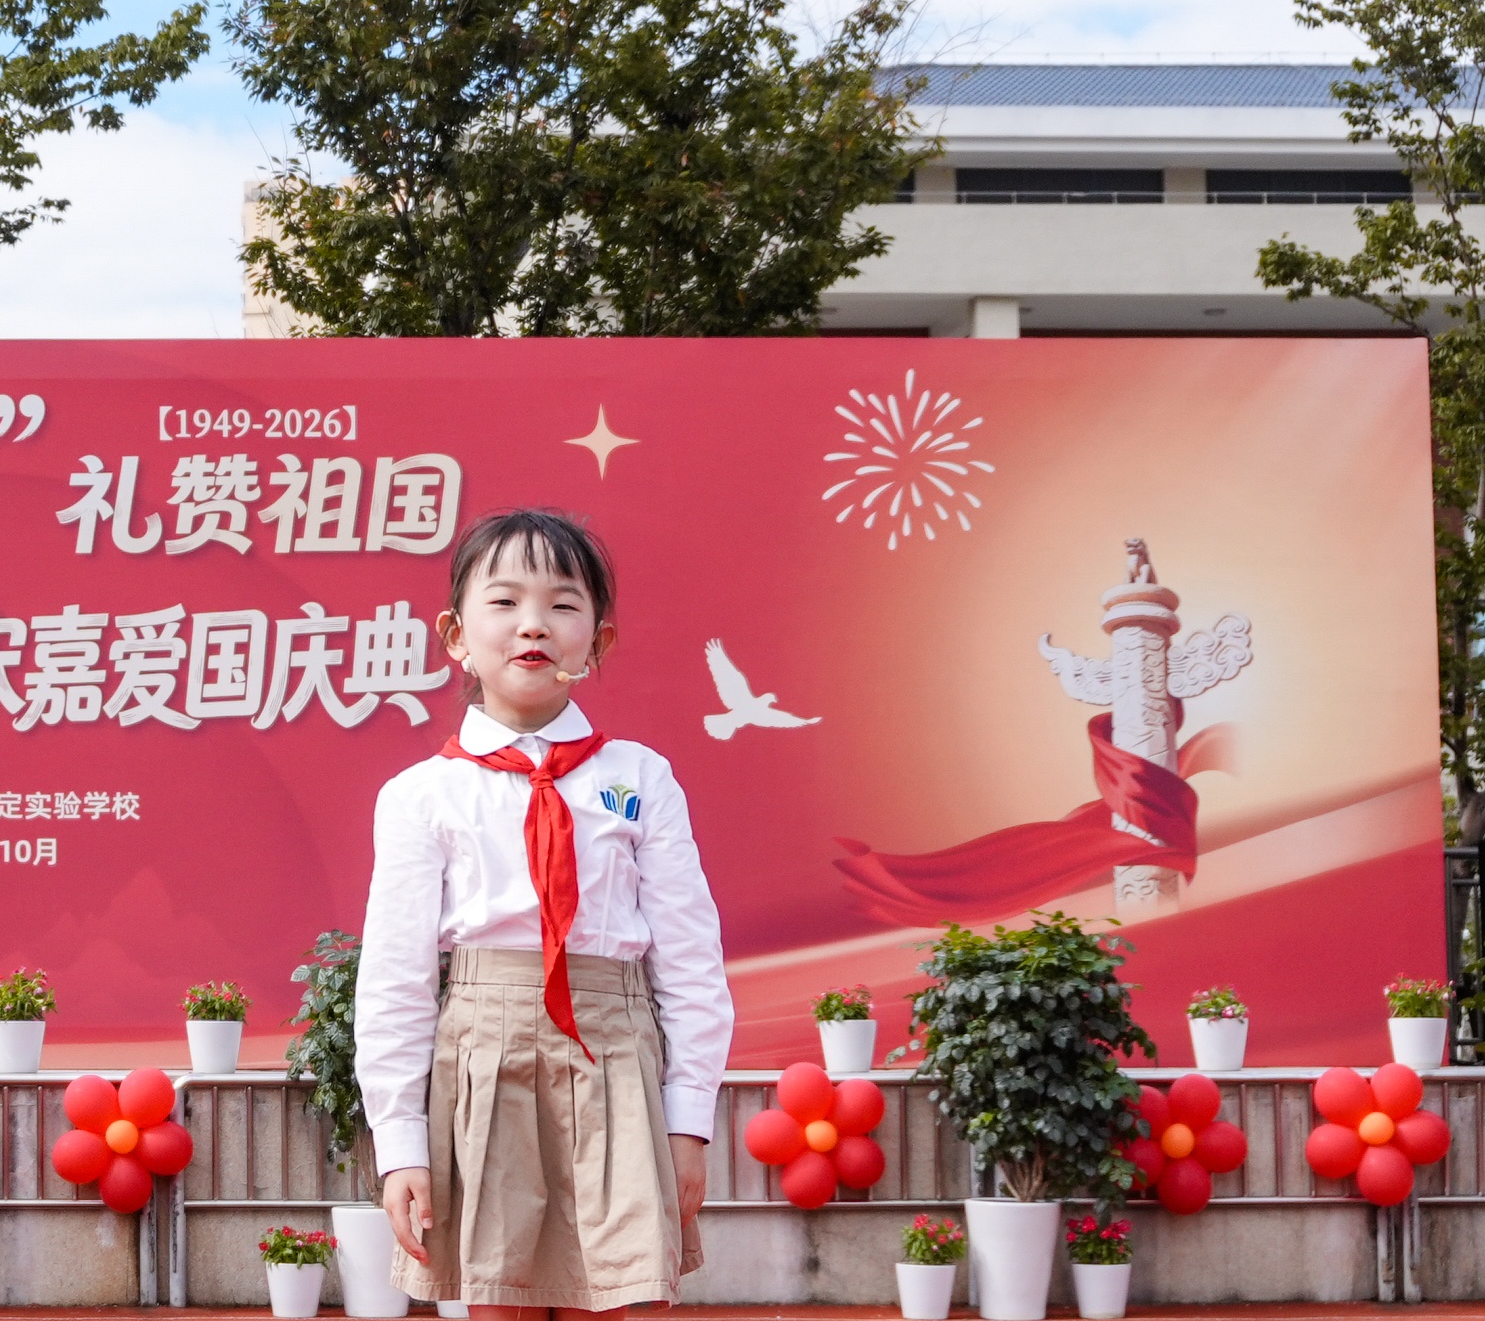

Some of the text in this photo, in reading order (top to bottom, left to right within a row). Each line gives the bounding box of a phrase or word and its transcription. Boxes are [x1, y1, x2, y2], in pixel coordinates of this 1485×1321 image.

[159, 405, 356, 440] 【1949-2026】
[56, 453, 461, 555] 礼赞祖国
